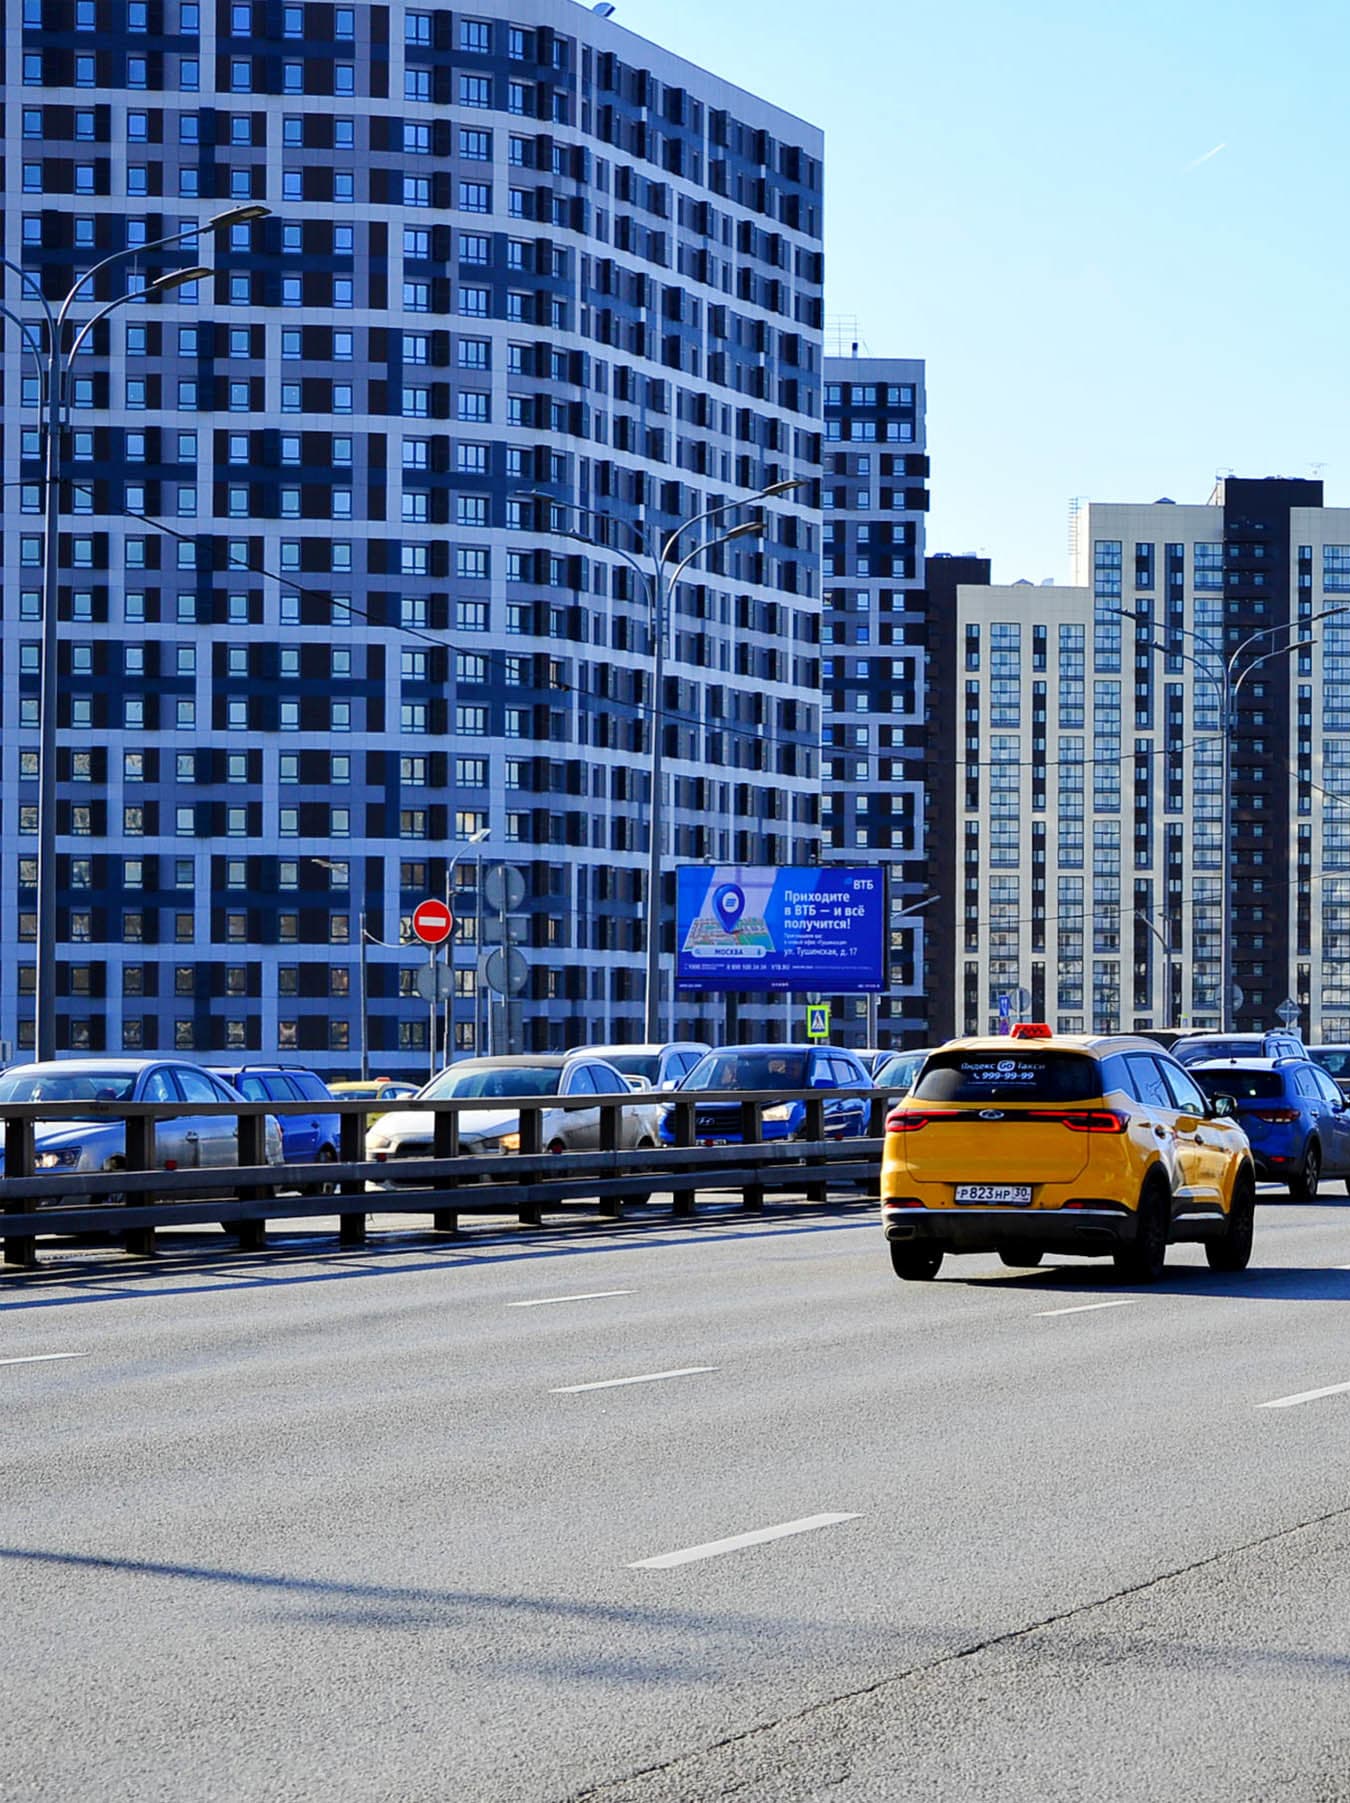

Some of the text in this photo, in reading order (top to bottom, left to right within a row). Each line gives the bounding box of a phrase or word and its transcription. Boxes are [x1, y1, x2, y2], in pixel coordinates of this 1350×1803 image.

[853, 880, 874, 890] ВТБ
[784, 890, 850, 904] Приходите
[784, 907, 791, 916] в
[795, 905, 816, 916] ВТБ
[834, 907, 842, 916] и
[845, 905, 865, 916] всё
[784, 918, 851, 932] получится!
[982, 1072, 1034, 1080] 999-99-99
